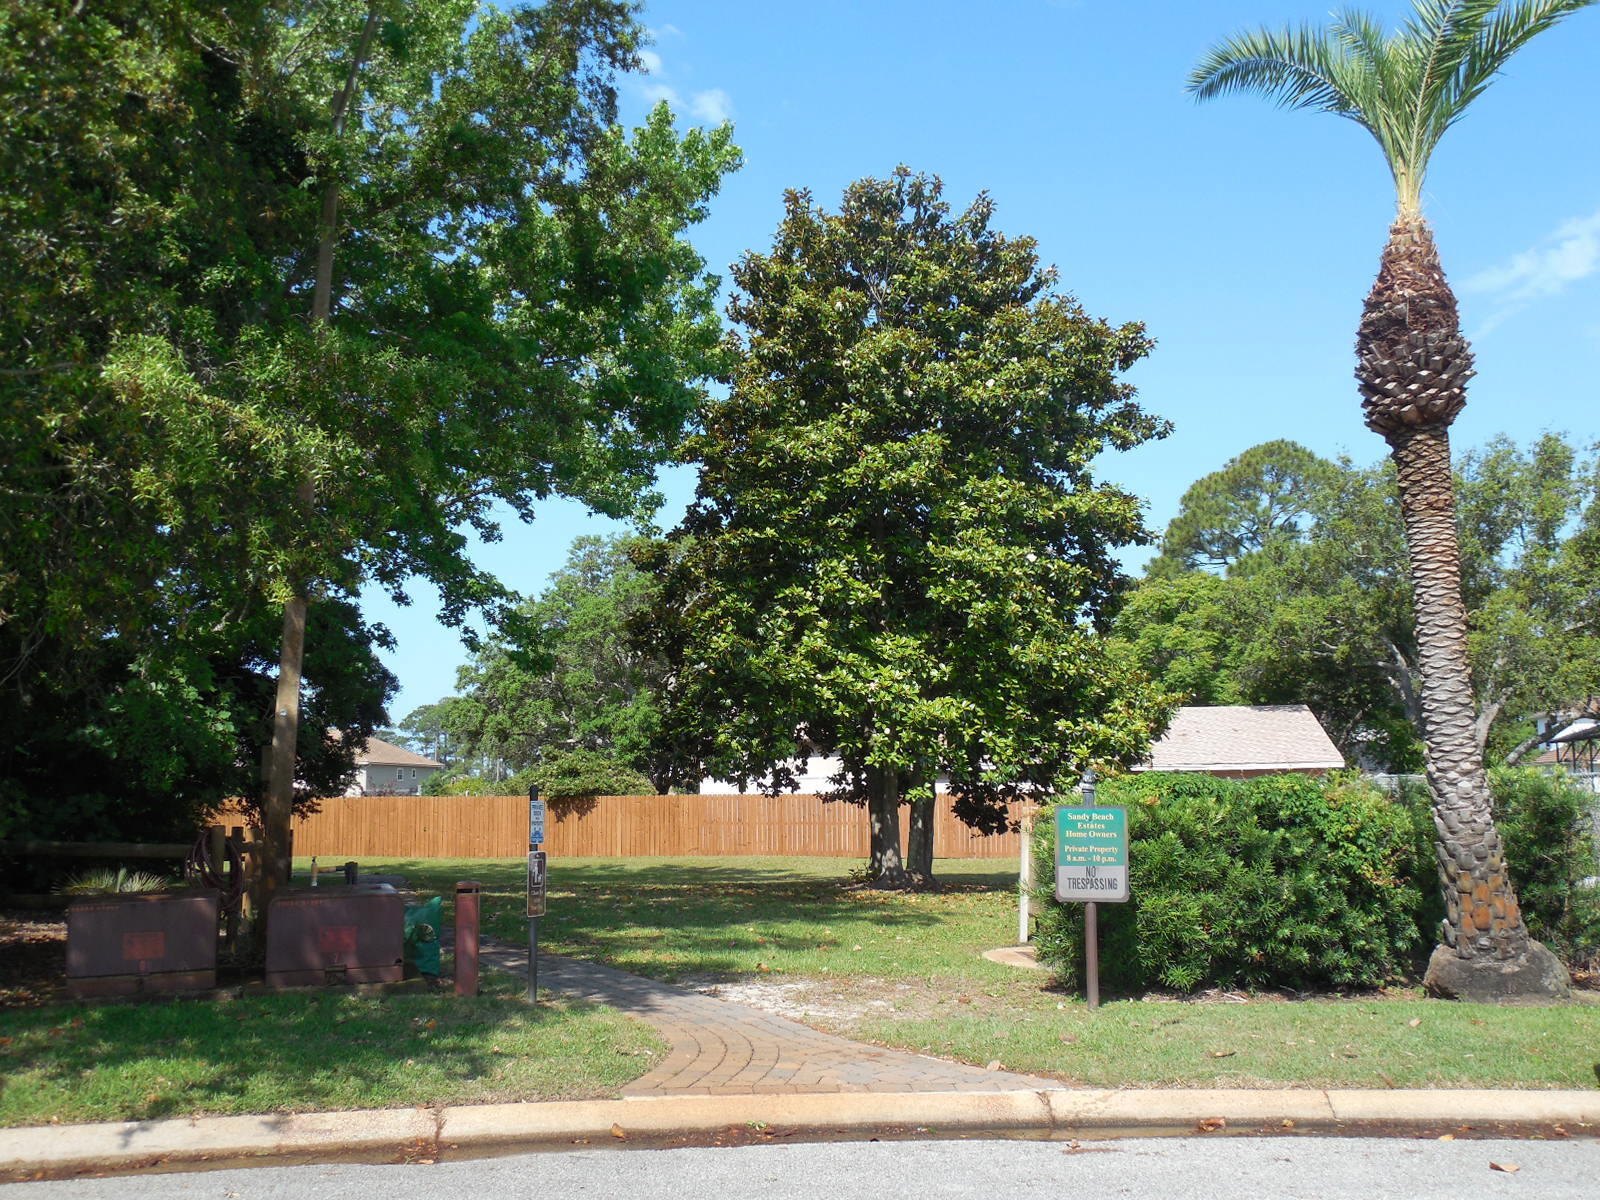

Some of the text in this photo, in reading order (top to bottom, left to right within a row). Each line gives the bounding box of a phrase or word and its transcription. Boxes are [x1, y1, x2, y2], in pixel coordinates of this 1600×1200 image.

[1067, 812, 1114, 822] Sandy Beach
[1066, 830, 1117, 838] Home Owners
[1064, 845, 1119, 855] Private Property
[1101, 855, 1117, 863] p.m.
[1085, 866, 1097, 878] NO
[1067, 877, 1118, 890] TRESPASSING
